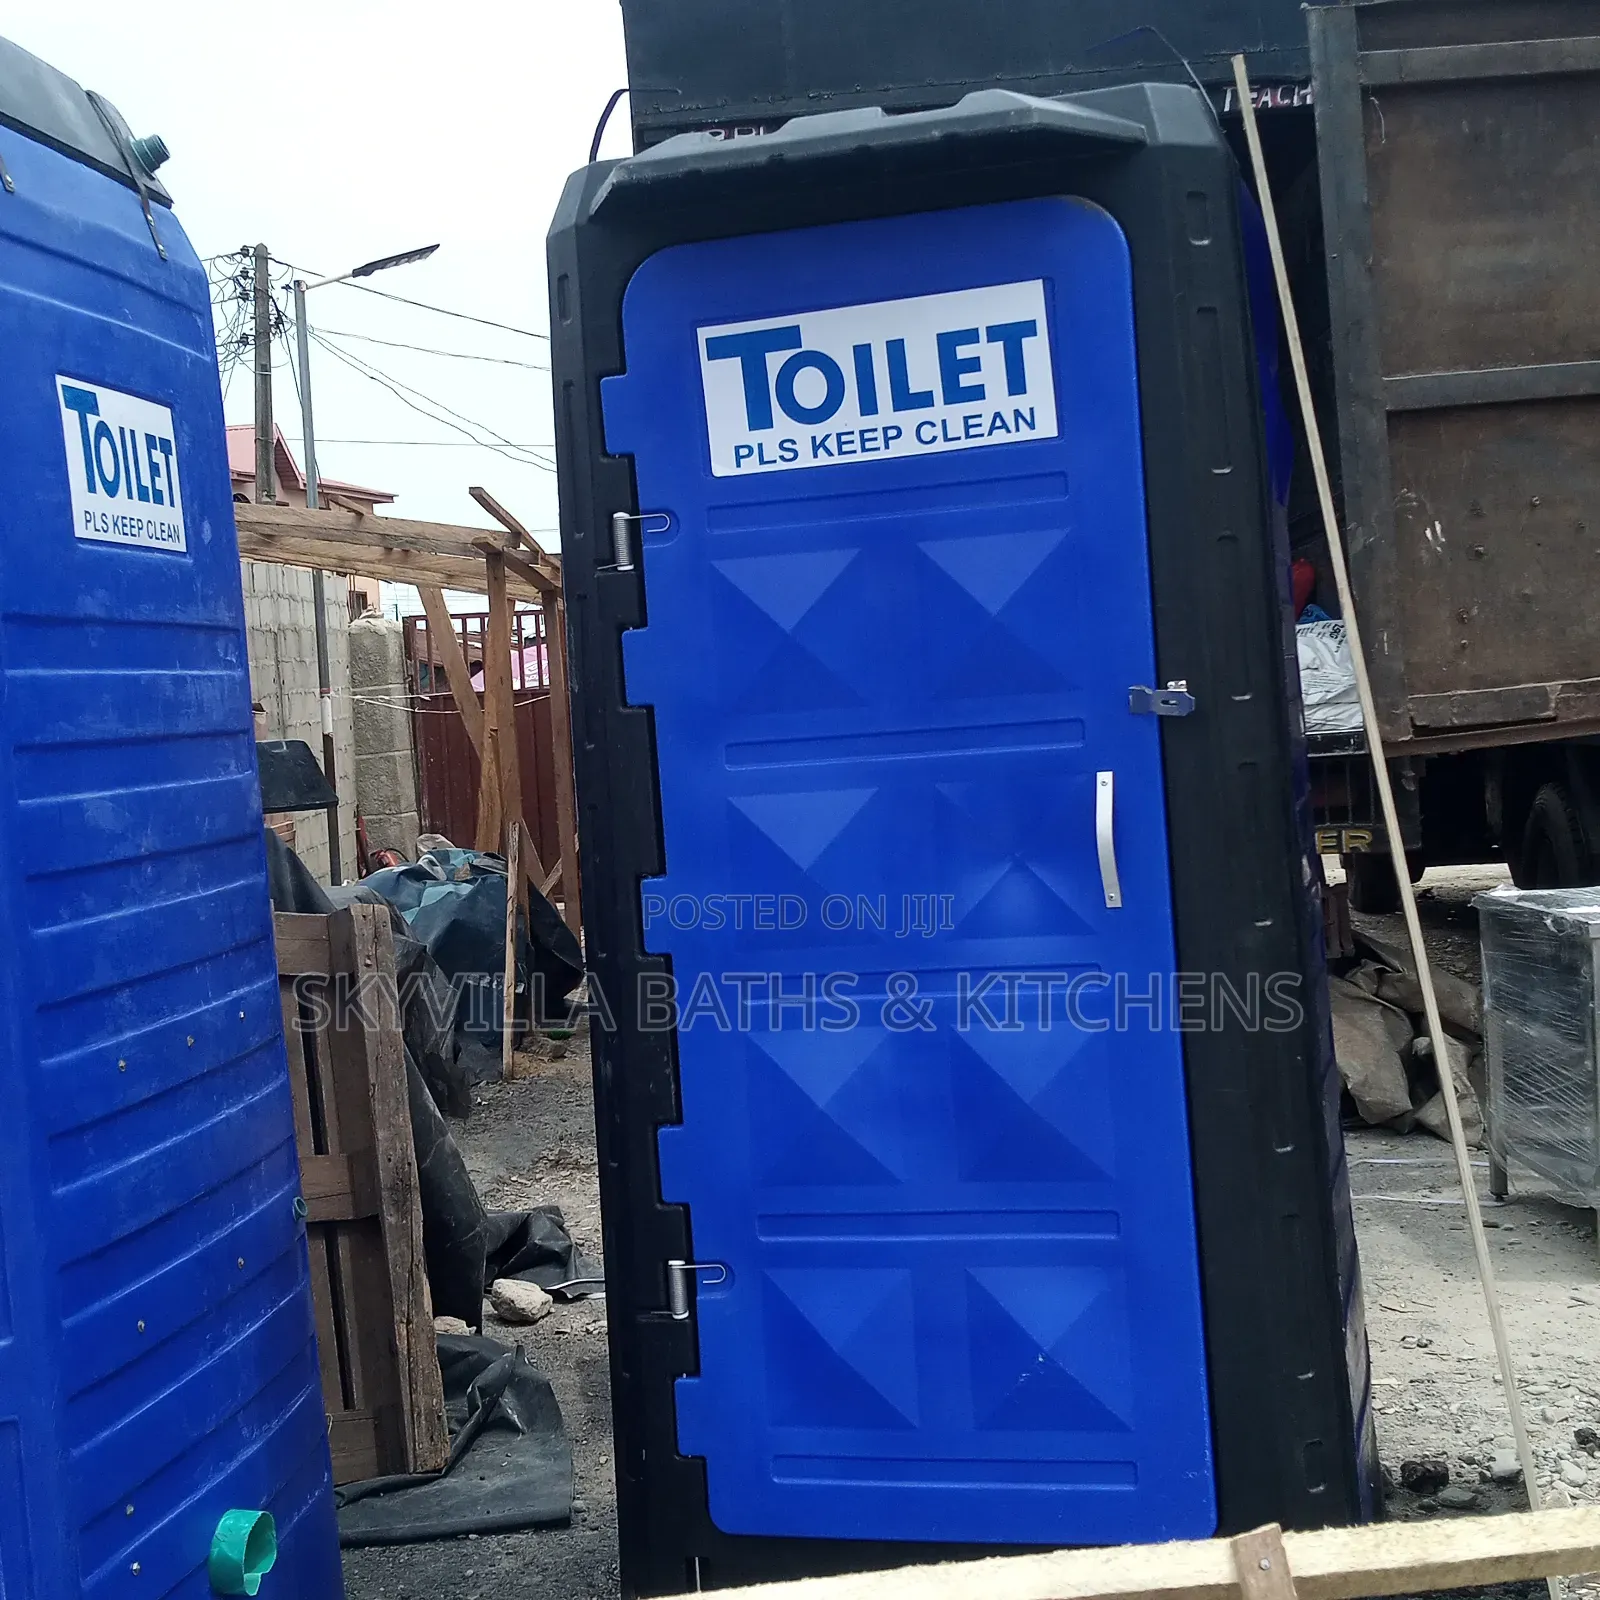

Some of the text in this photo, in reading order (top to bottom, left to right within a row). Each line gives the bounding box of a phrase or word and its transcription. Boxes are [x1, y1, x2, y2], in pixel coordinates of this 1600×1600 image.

[704, 318, 1038, 432] TOILET
[61, 384, 175, 508] TOILET
[733, 406, 1037, 468] PLS KEEP CLEAN
[84, 510, 181, 544] PLS KEEP CLEAN
